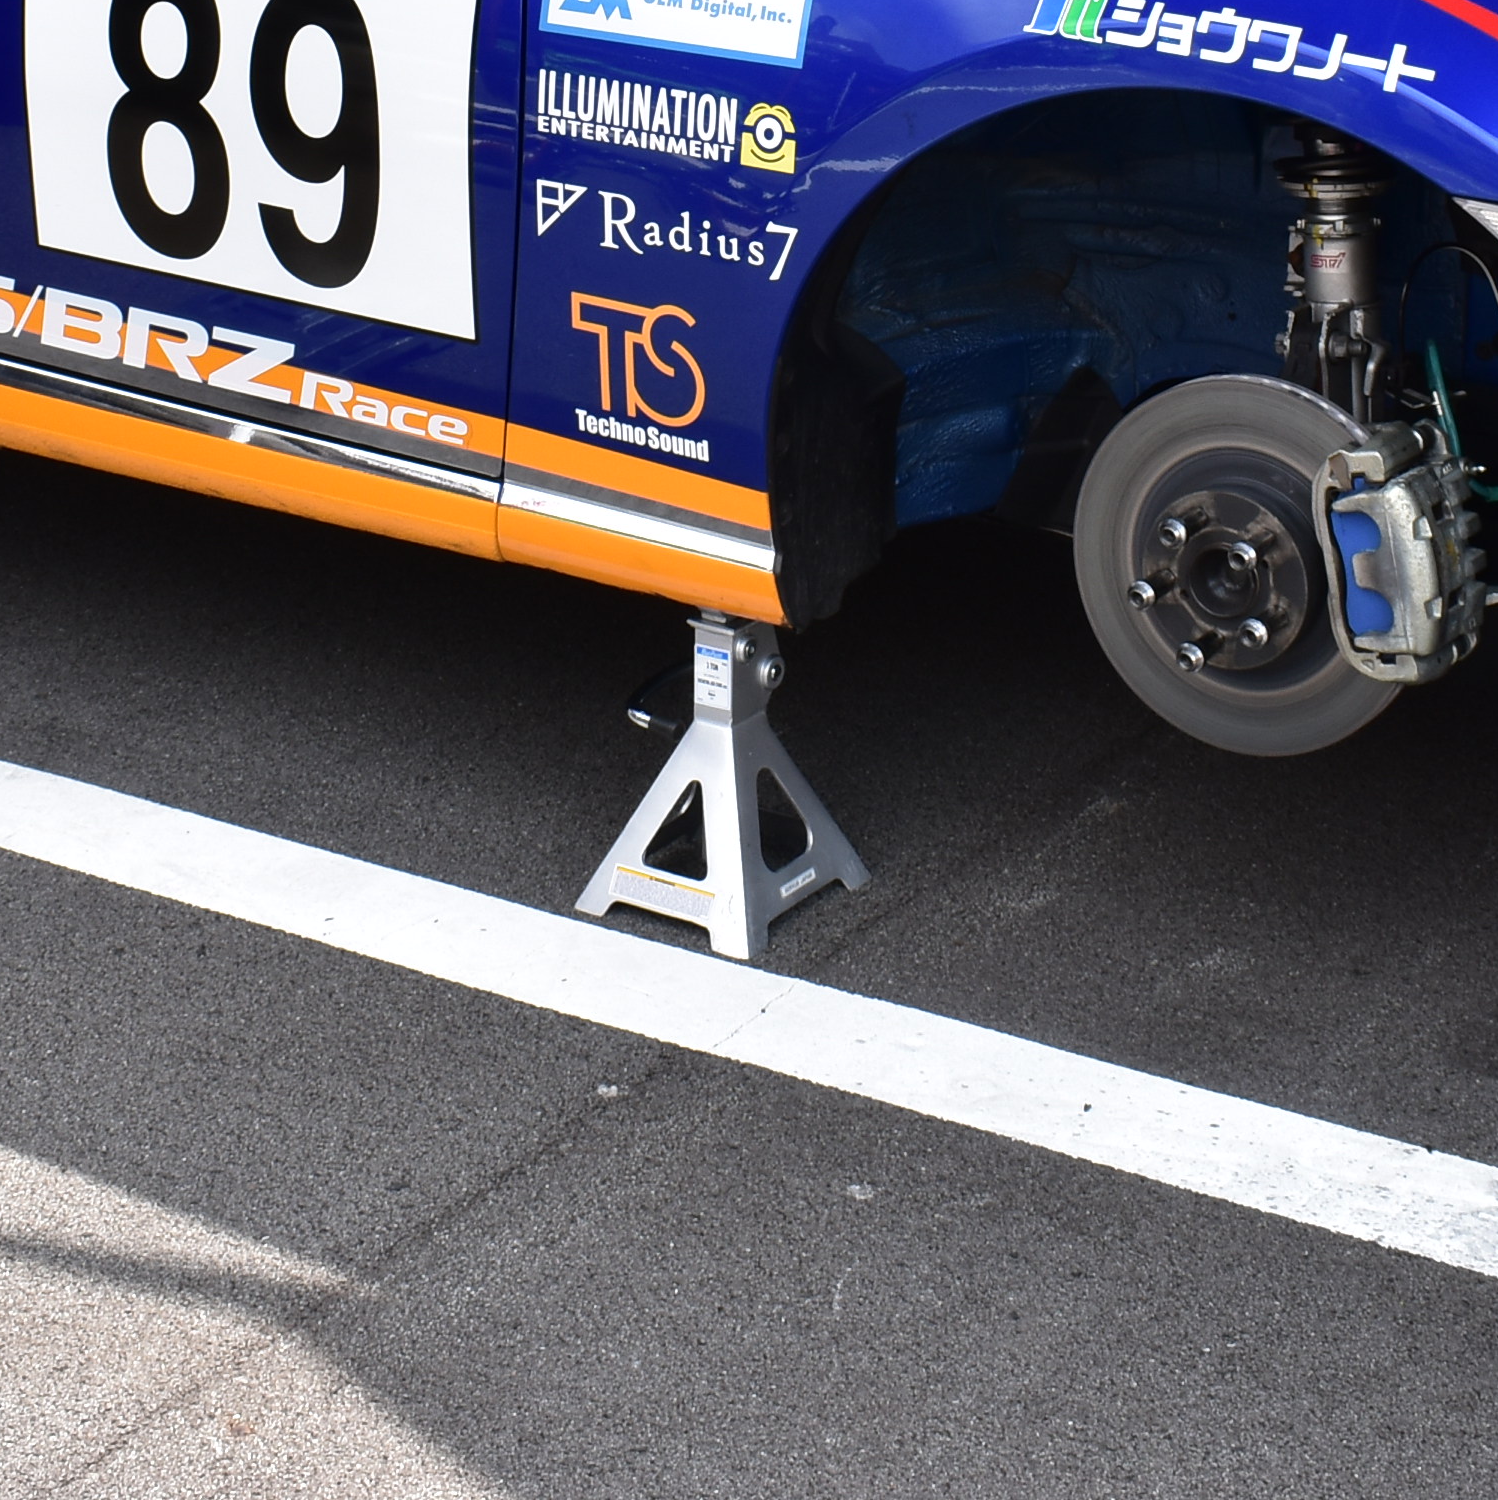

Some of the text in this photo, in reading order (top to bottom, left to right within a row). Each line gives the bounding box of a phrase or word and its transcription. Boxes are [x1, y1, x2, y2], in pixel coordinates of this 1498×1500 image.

[760, 5, 794, 24] Inc.
[537, 115, 736, 164] ENTERTAINMENT
[538, 69, 739, 146] ILLUMINATION
[598, 190, 799, 281] Radius7
[299, 373, 468, 445] Race
